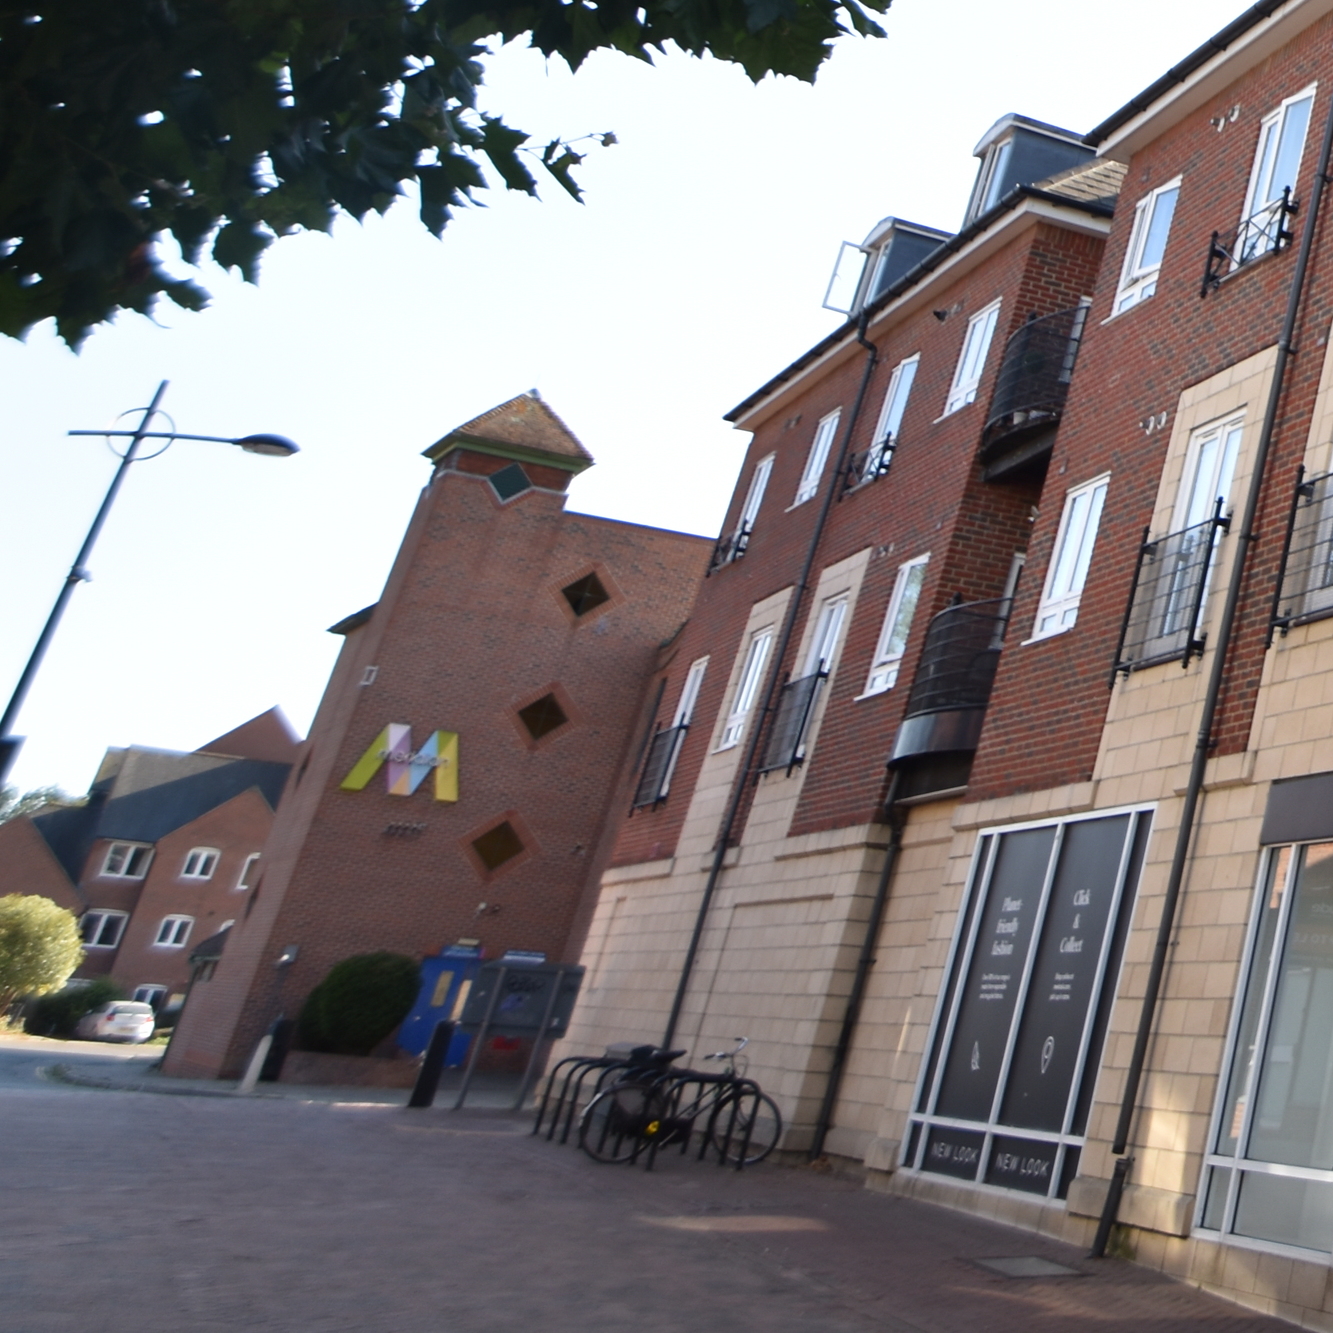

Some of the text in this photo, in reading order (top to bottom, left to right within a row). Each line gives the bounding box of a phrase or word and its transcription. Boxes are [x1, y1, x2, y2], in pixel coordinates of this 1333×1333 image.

[931, 1142, 979, 1163] NEW LOOK
[995, 1153, 1050, 1176] NEW LOOK
